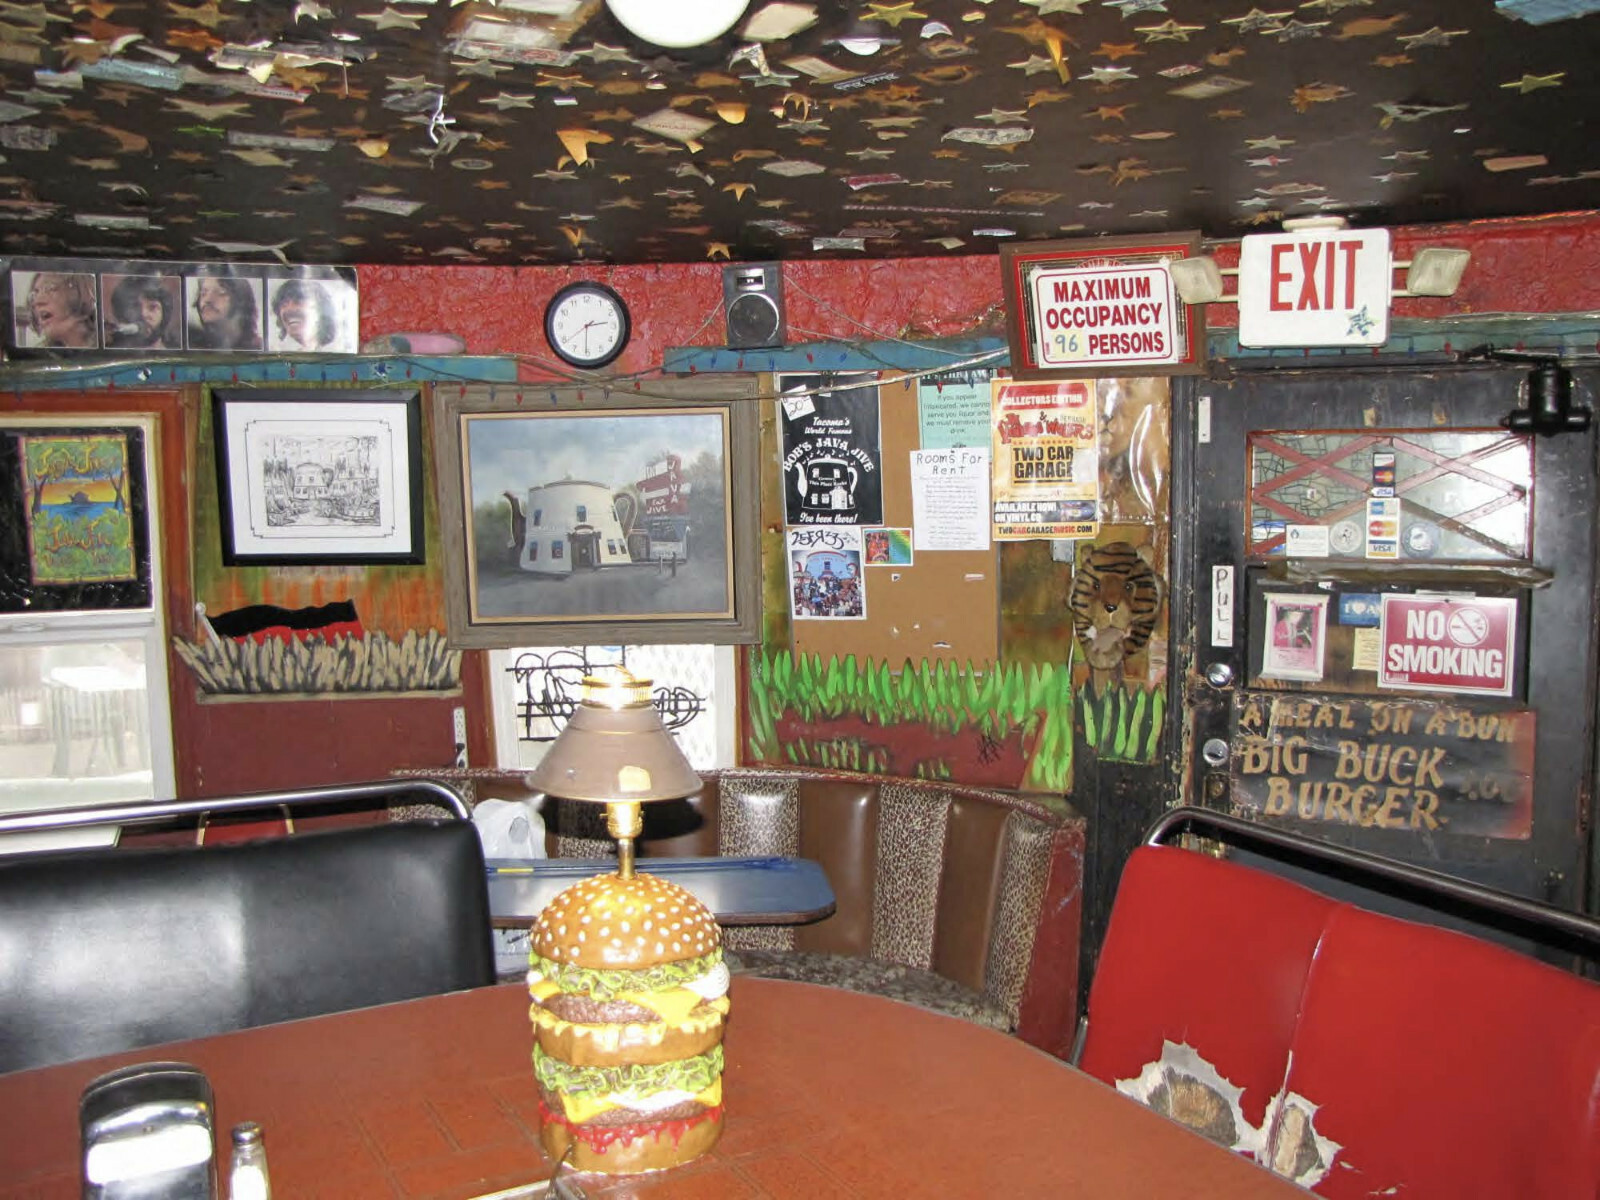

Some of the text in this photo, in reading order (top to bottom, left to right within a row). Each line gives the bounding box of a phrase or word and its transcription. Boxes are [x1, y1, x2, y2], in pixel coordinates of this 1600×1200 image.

[1270, 240, 1363, 311] EXIT
[1053, 277, 1150, 302] MAXIMUM
[1046, 303, 1162, 329] OCCUPANCY
[1054, 334, 1078, 353] 96
[1089, 331, 1164, 355] PERSONS
[813, 417, 850, 426] Tacoma's
[783, 438, 874, 473] BOB'S JAVA JIVE
[1013, 445, 1074, 461] TWO CAR
[1014, 461, 1073, 478] GARAGE
[816, 513, 832, 523] been
[834, 513, 858, 524] there!
[998, 525, 1093, 534] TWOCARGARAGEMUSIC.COM
[1406, 609, 1445, 641] NO
[1387, 643, 1503, 678] SMOKING
[1238, 703, 1262, 727] A
[1278, 703, 1354, 729] MEAL
[1425, 710, 1447, 735] A
[1458, 710, 1518, 743] BUN
[1335, 740, 1447, 789] BUCK
